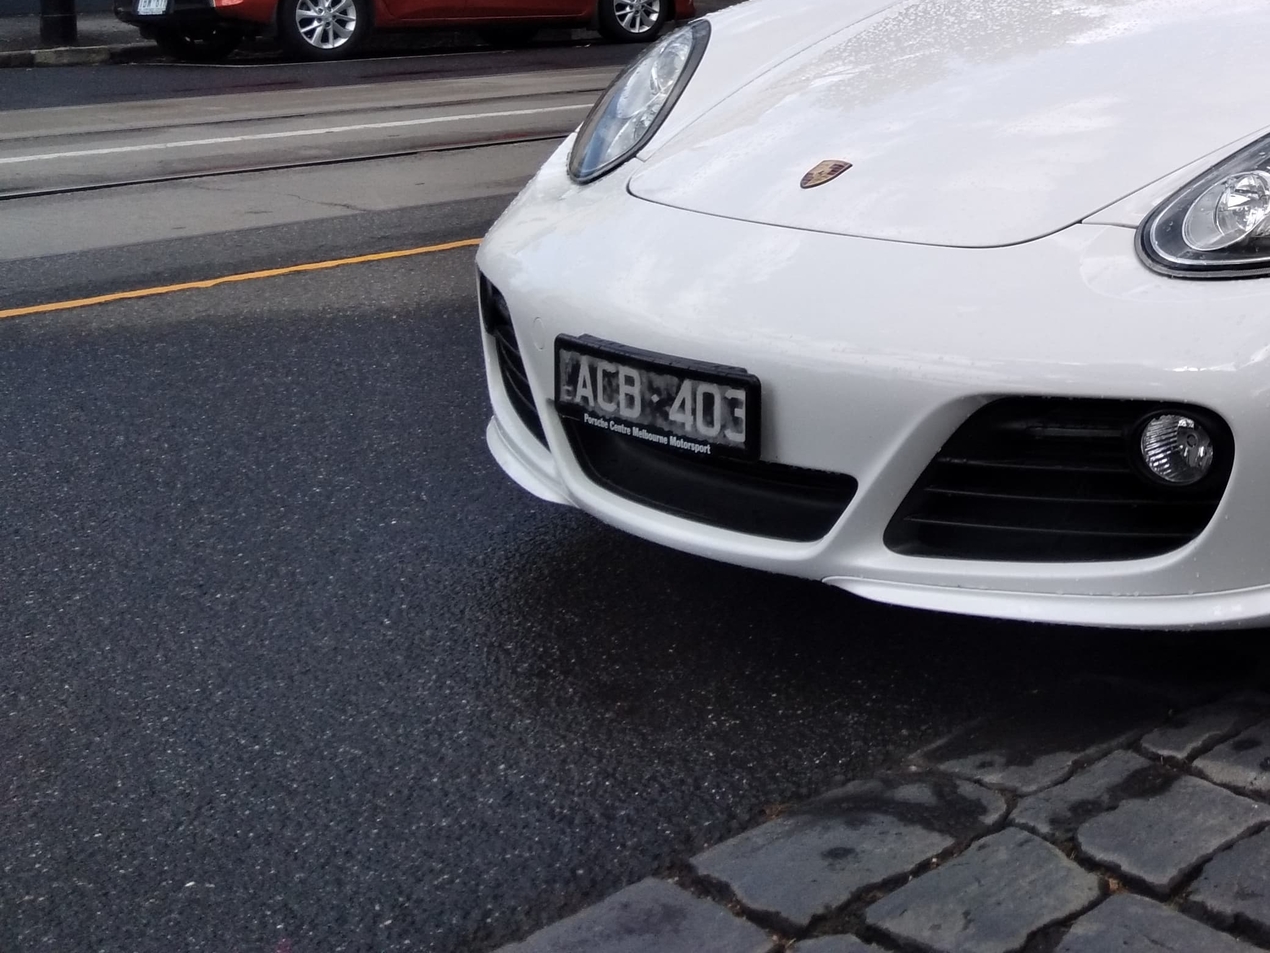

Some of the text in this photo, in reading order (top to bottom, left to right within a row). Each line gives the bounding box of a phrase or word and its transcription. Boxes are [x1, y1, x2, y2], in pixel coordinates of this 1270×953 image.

[583, 413, 711, 454] Porsche Centre Melbourne Motorsport
